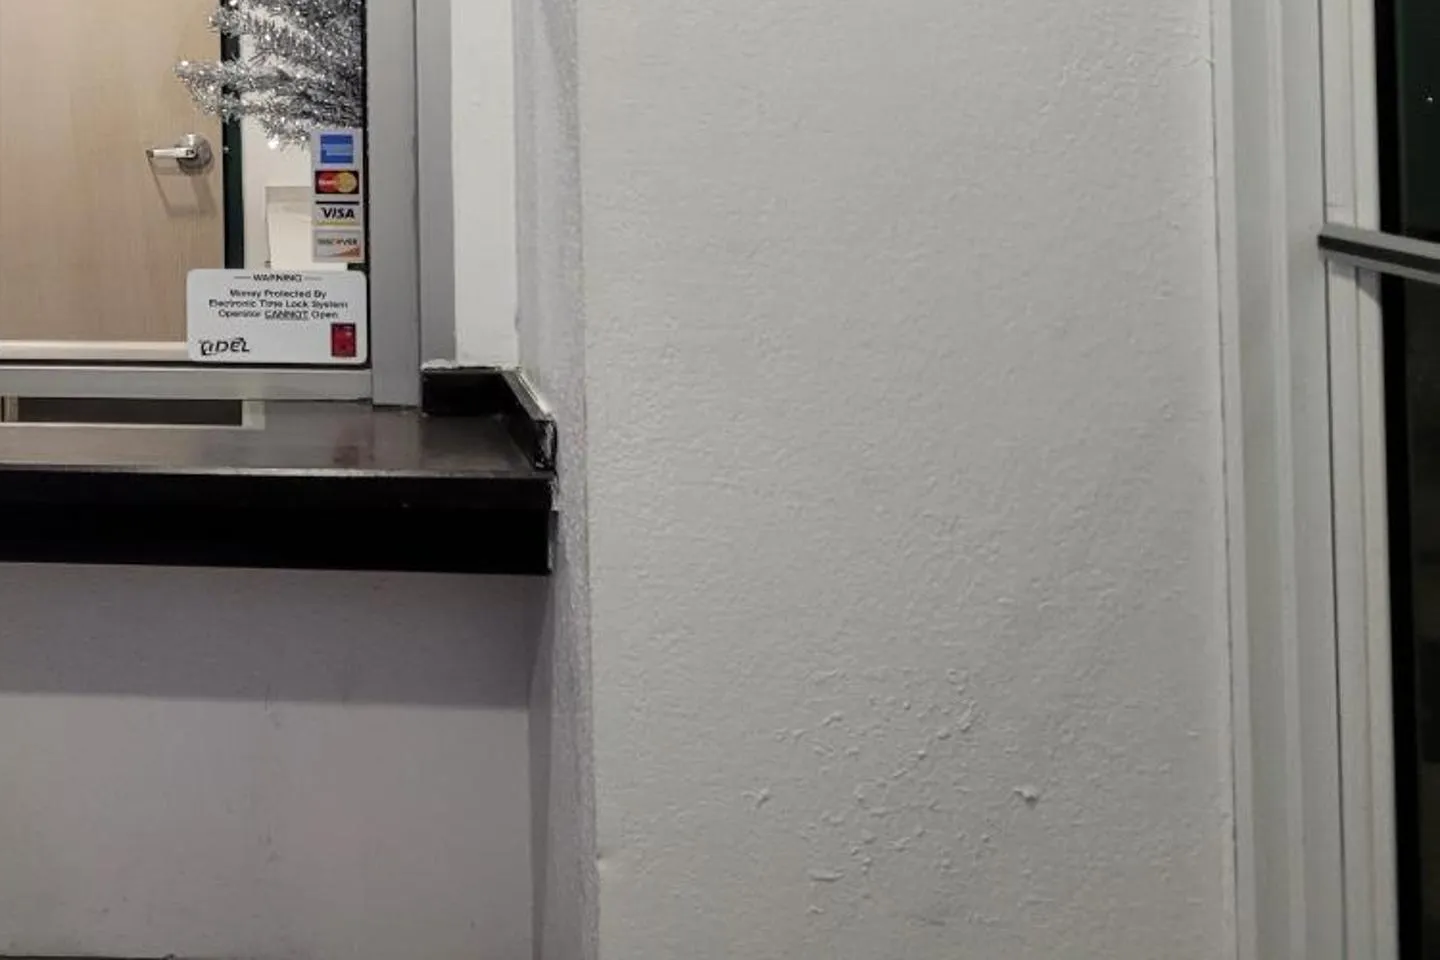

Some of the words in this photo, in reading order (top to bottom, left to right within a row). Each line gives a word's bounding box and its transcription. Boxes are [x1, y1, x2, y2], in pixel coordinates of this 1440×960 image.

[321, 207, 355, 220] VISA
[253, 274, 302, 282] WARNING
[229, 289, 261, 299] Money
[264, 289, 311, 298] Protected
[314, 290, 327, 300] By
[209, 299, 256, 308] Electronic
[260, 299, 283, 308] Time
[286, 300, 308, 308] Lock
[312, 300, 348, 310] System
[218, 309, 261, 319] Operator
[264, 310, 309, 320] CANNOT
[311, 311, 338, 320] Open
